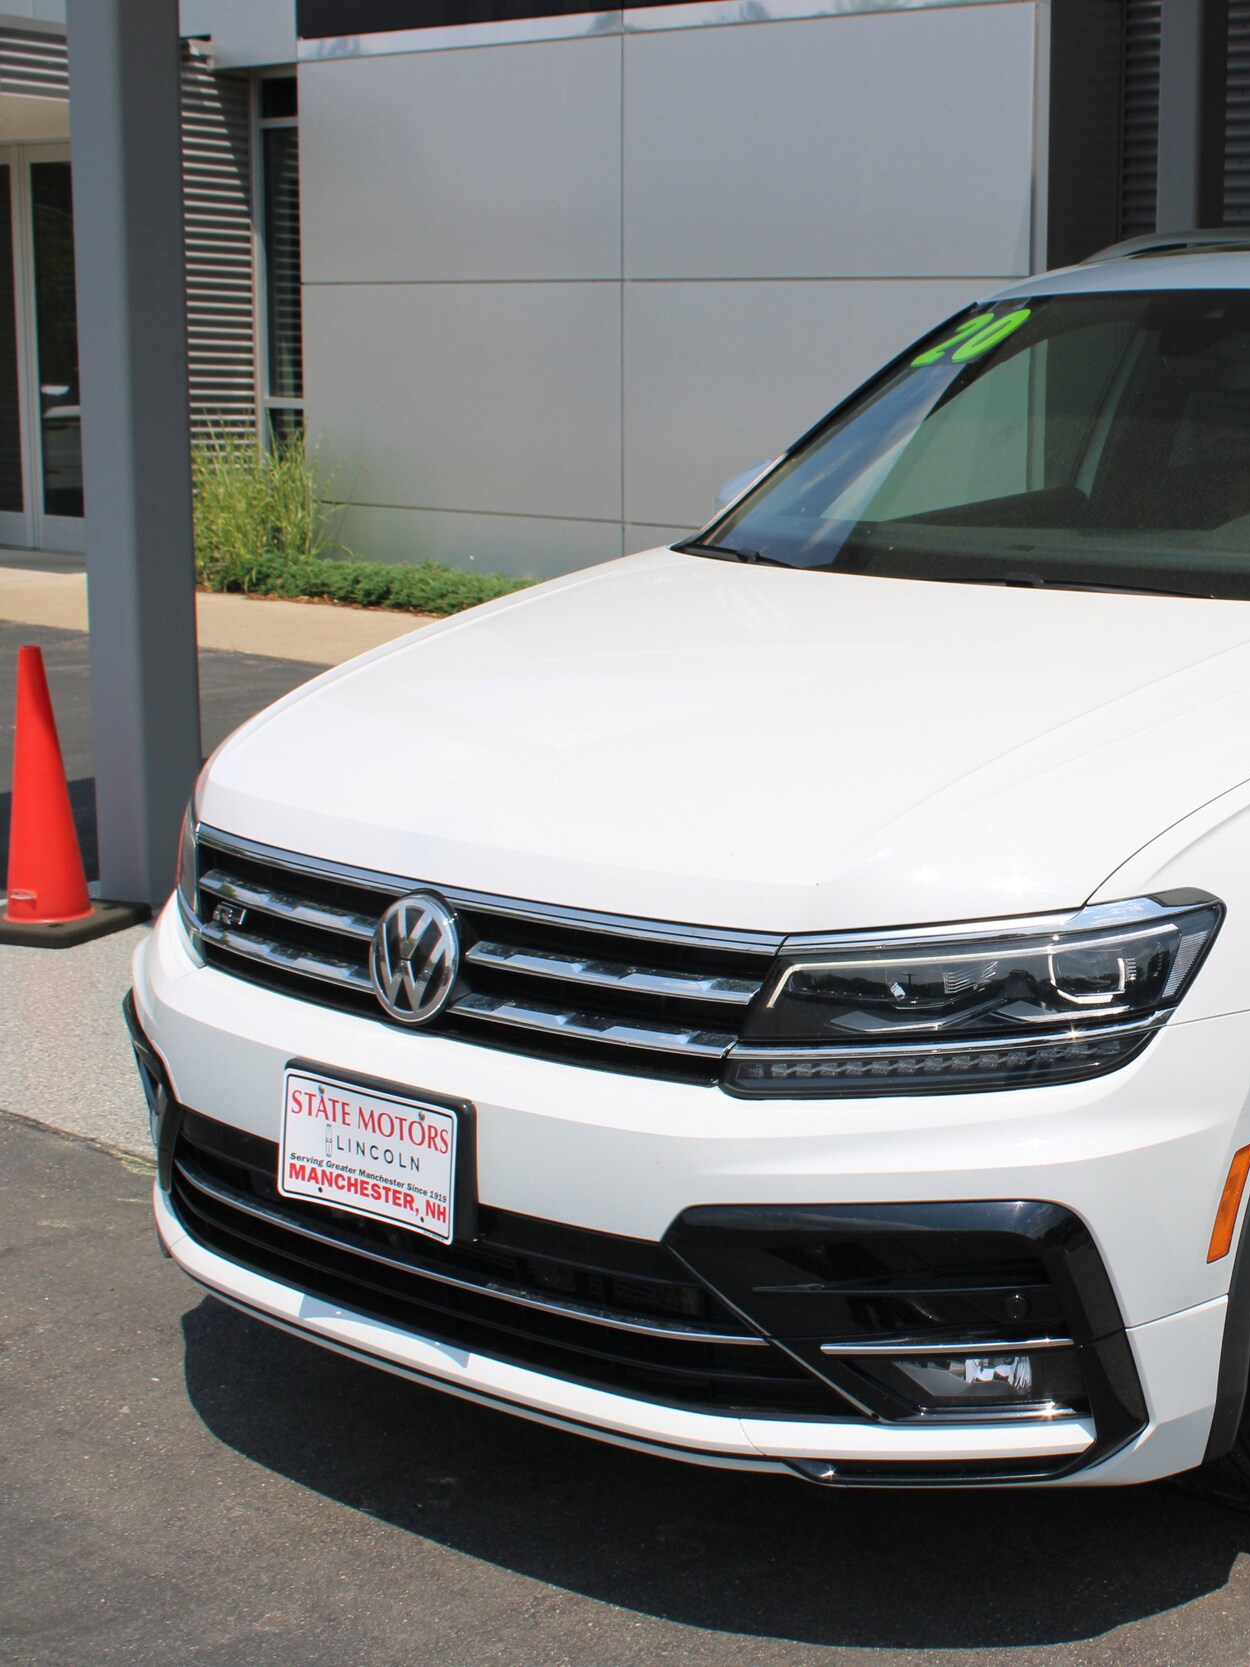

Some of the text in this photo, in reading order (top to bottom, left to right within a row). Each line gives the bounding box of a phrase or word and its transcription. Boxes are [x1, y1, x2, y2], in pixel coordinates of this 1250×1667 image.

[910, 308, 1031, 368] 20
[291, 1089, 449, 1155] STATE MOTORS
[290, 1152, 324, 1168] Serving
[325, 1159, 357, 1174] Greater
[358, 1169, 405, 1189] Manchester
[406, 1183, 428, 1197] Since
[336, 1135, 420, 1173] LINCOLN
[289, 1162, 447, 1224] MANCHESTER, NH
